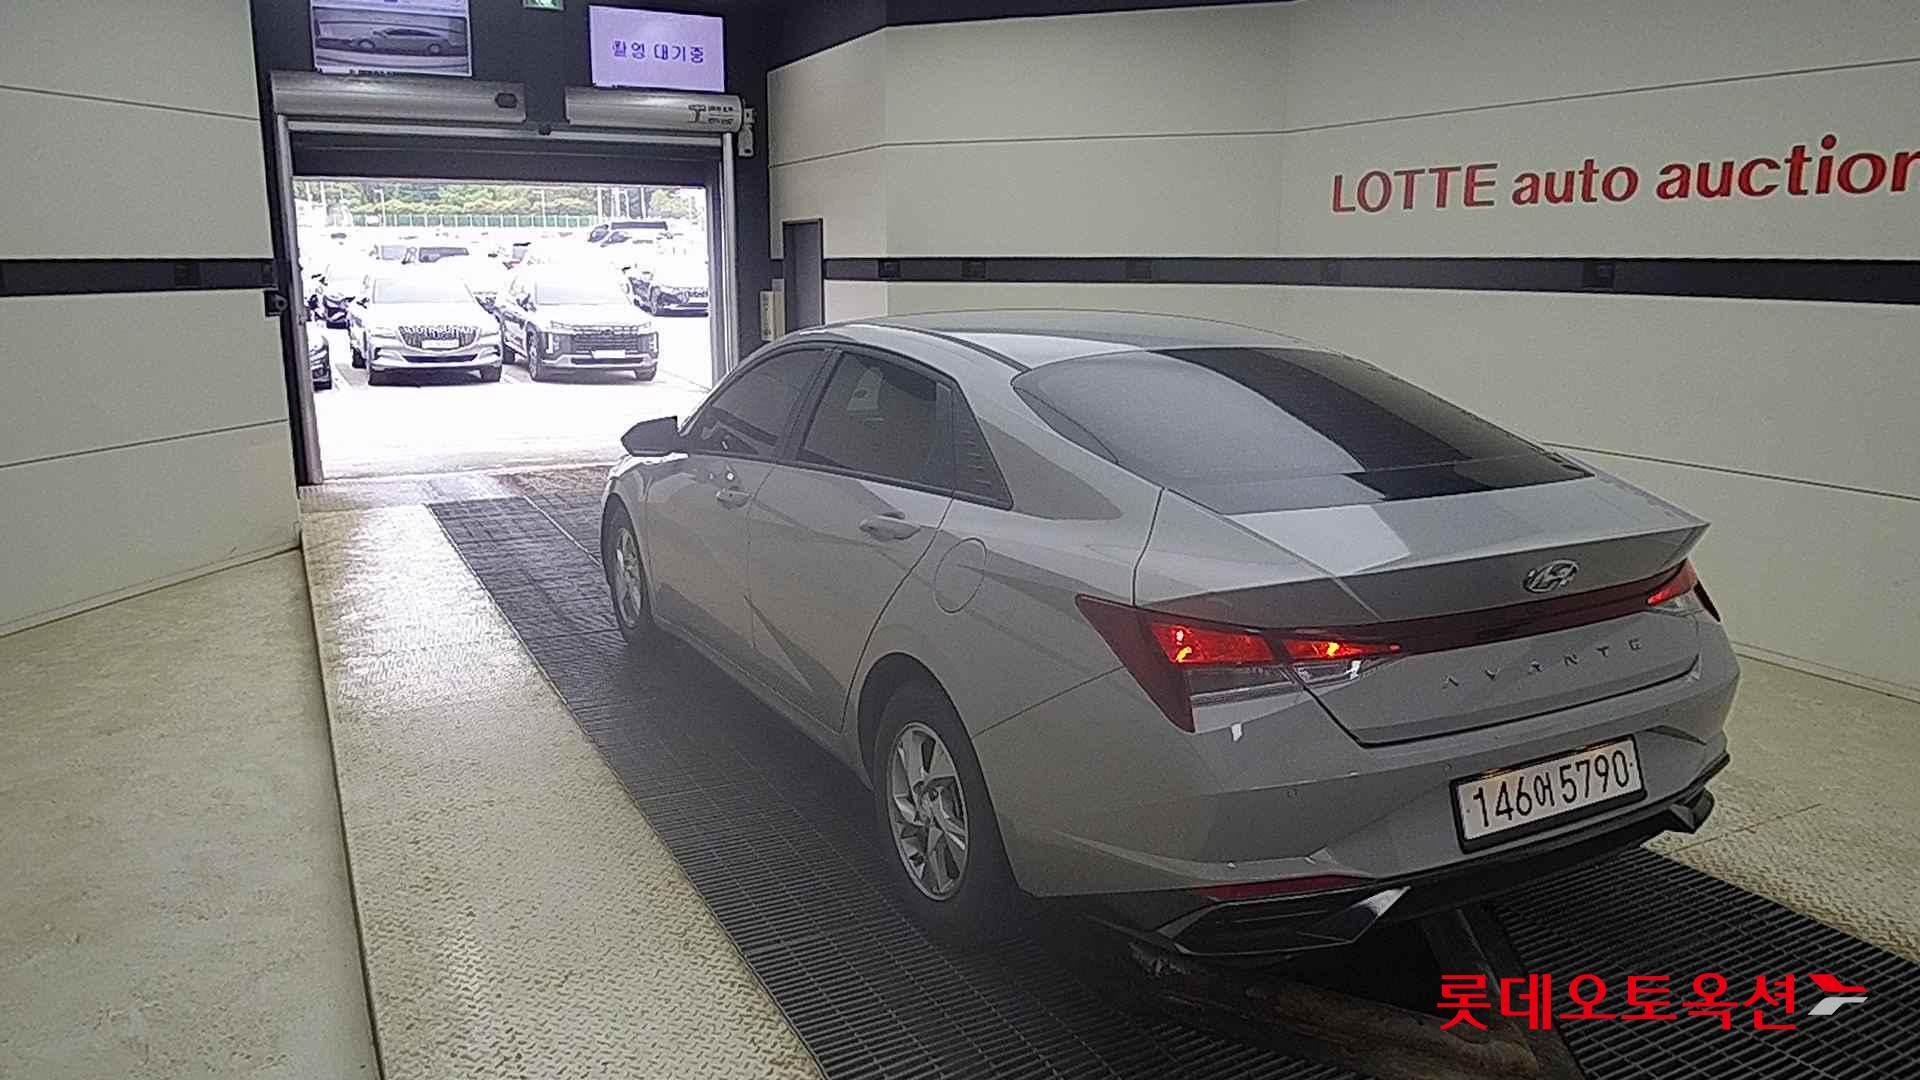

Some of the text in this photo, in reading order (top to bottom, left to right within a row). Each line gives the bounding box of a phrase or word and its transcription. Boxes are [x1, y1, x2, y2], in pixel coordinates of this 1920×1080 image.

[654, 43, 704, 63] 대기중
[1332, 162, 1498, 213] LOTTE
[1511, 158, 1639, 206] auto
[1442, 637, 1643, 690] AVANTE
